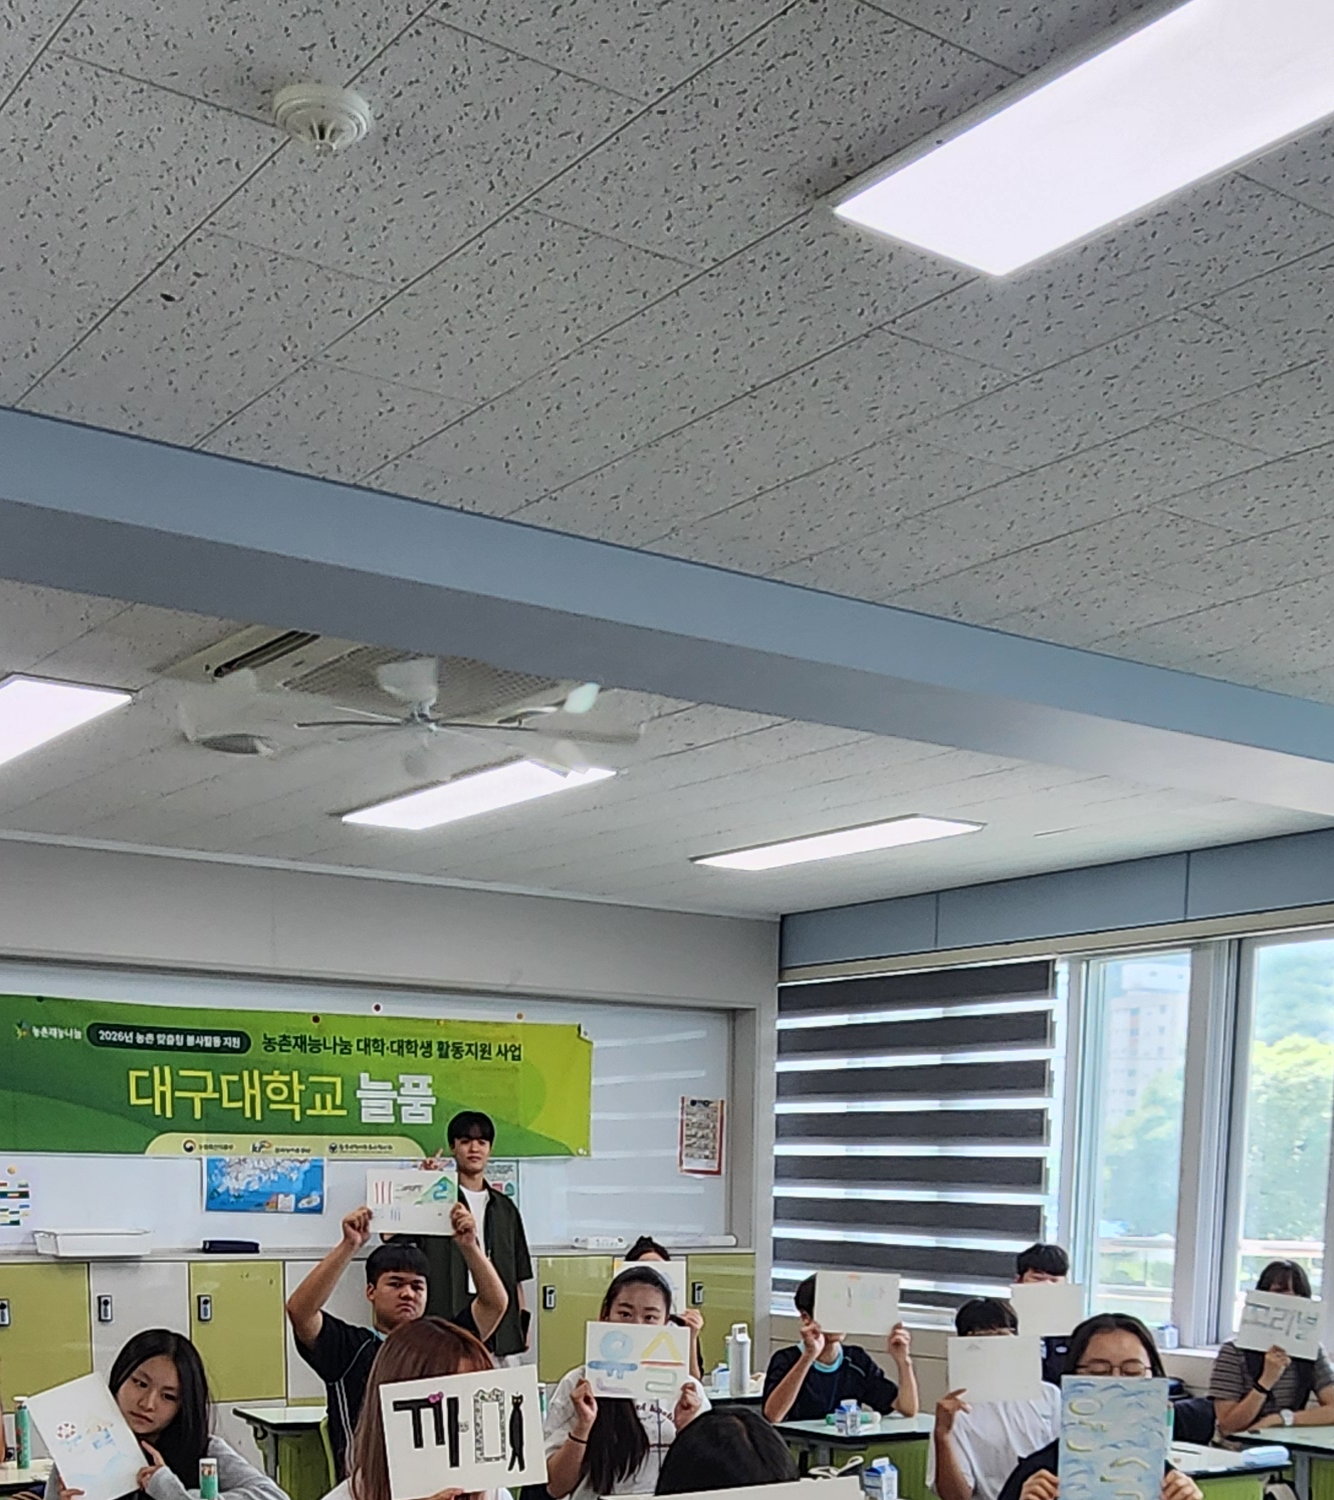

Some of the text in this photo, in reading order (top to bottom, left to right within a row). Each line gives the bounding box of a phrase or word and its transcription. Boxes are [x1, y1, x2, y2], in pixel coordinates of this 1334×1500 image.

[98, 1029, 242, 1049] 2026년 농촌 맞춤형 봉사활동 지원
[262, 1032, 353, 1056] 농촌재능나눔
[436, 1040, 493, 1061] 활동지원
[496, 1043, 523, 1062] 사업
[128, 1065, 437, 1124] 대구대학교 늘품
[588, 1330, 686, 1394] 윤슬
